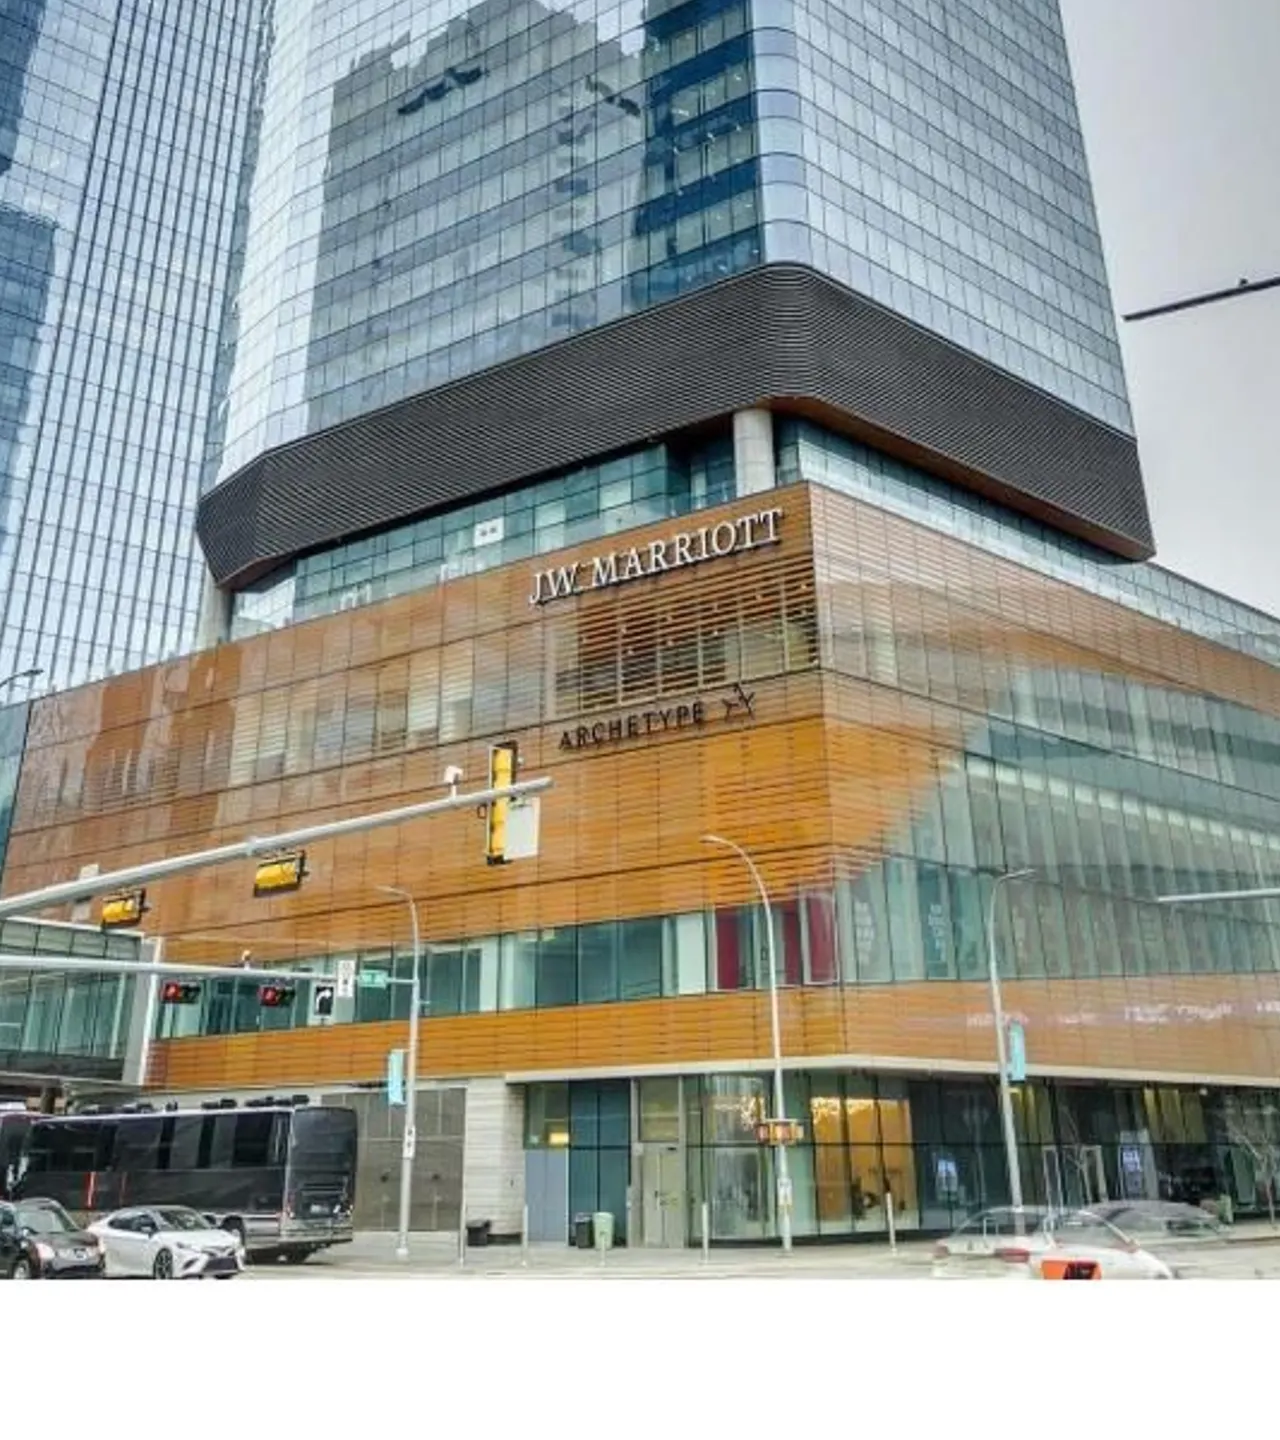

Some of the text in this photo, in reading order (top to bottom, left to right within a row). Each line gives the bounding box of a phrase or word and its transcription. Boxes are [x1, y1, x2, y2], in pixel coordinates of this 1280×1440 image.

[530, 509, 782, 604] JW MARRIOTT
[558, 700, 706, 750] ARCHETYPE
